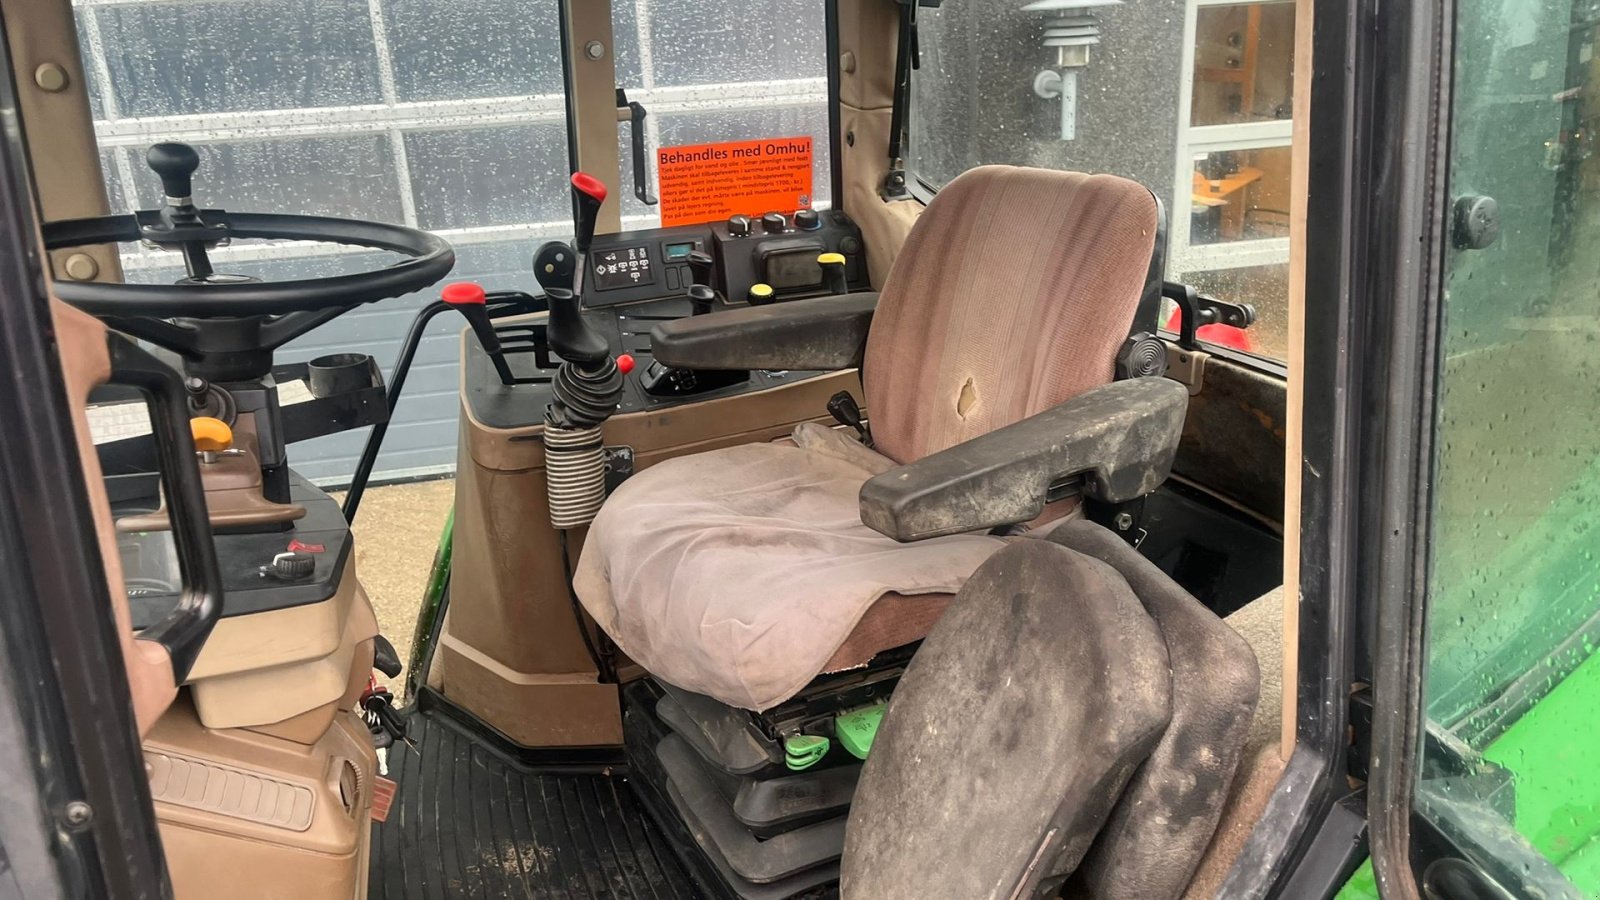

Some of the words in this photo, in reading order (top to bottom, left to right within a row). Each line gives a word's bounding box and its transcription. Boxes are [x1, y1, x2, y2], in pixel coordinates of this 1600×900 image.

[660, 147, 728, 164] Behandles
[732, 145, 761, 158] med
[766, 141, 810, 156] Omhu!
[702, 170, 740, 178] tilbageleveres
